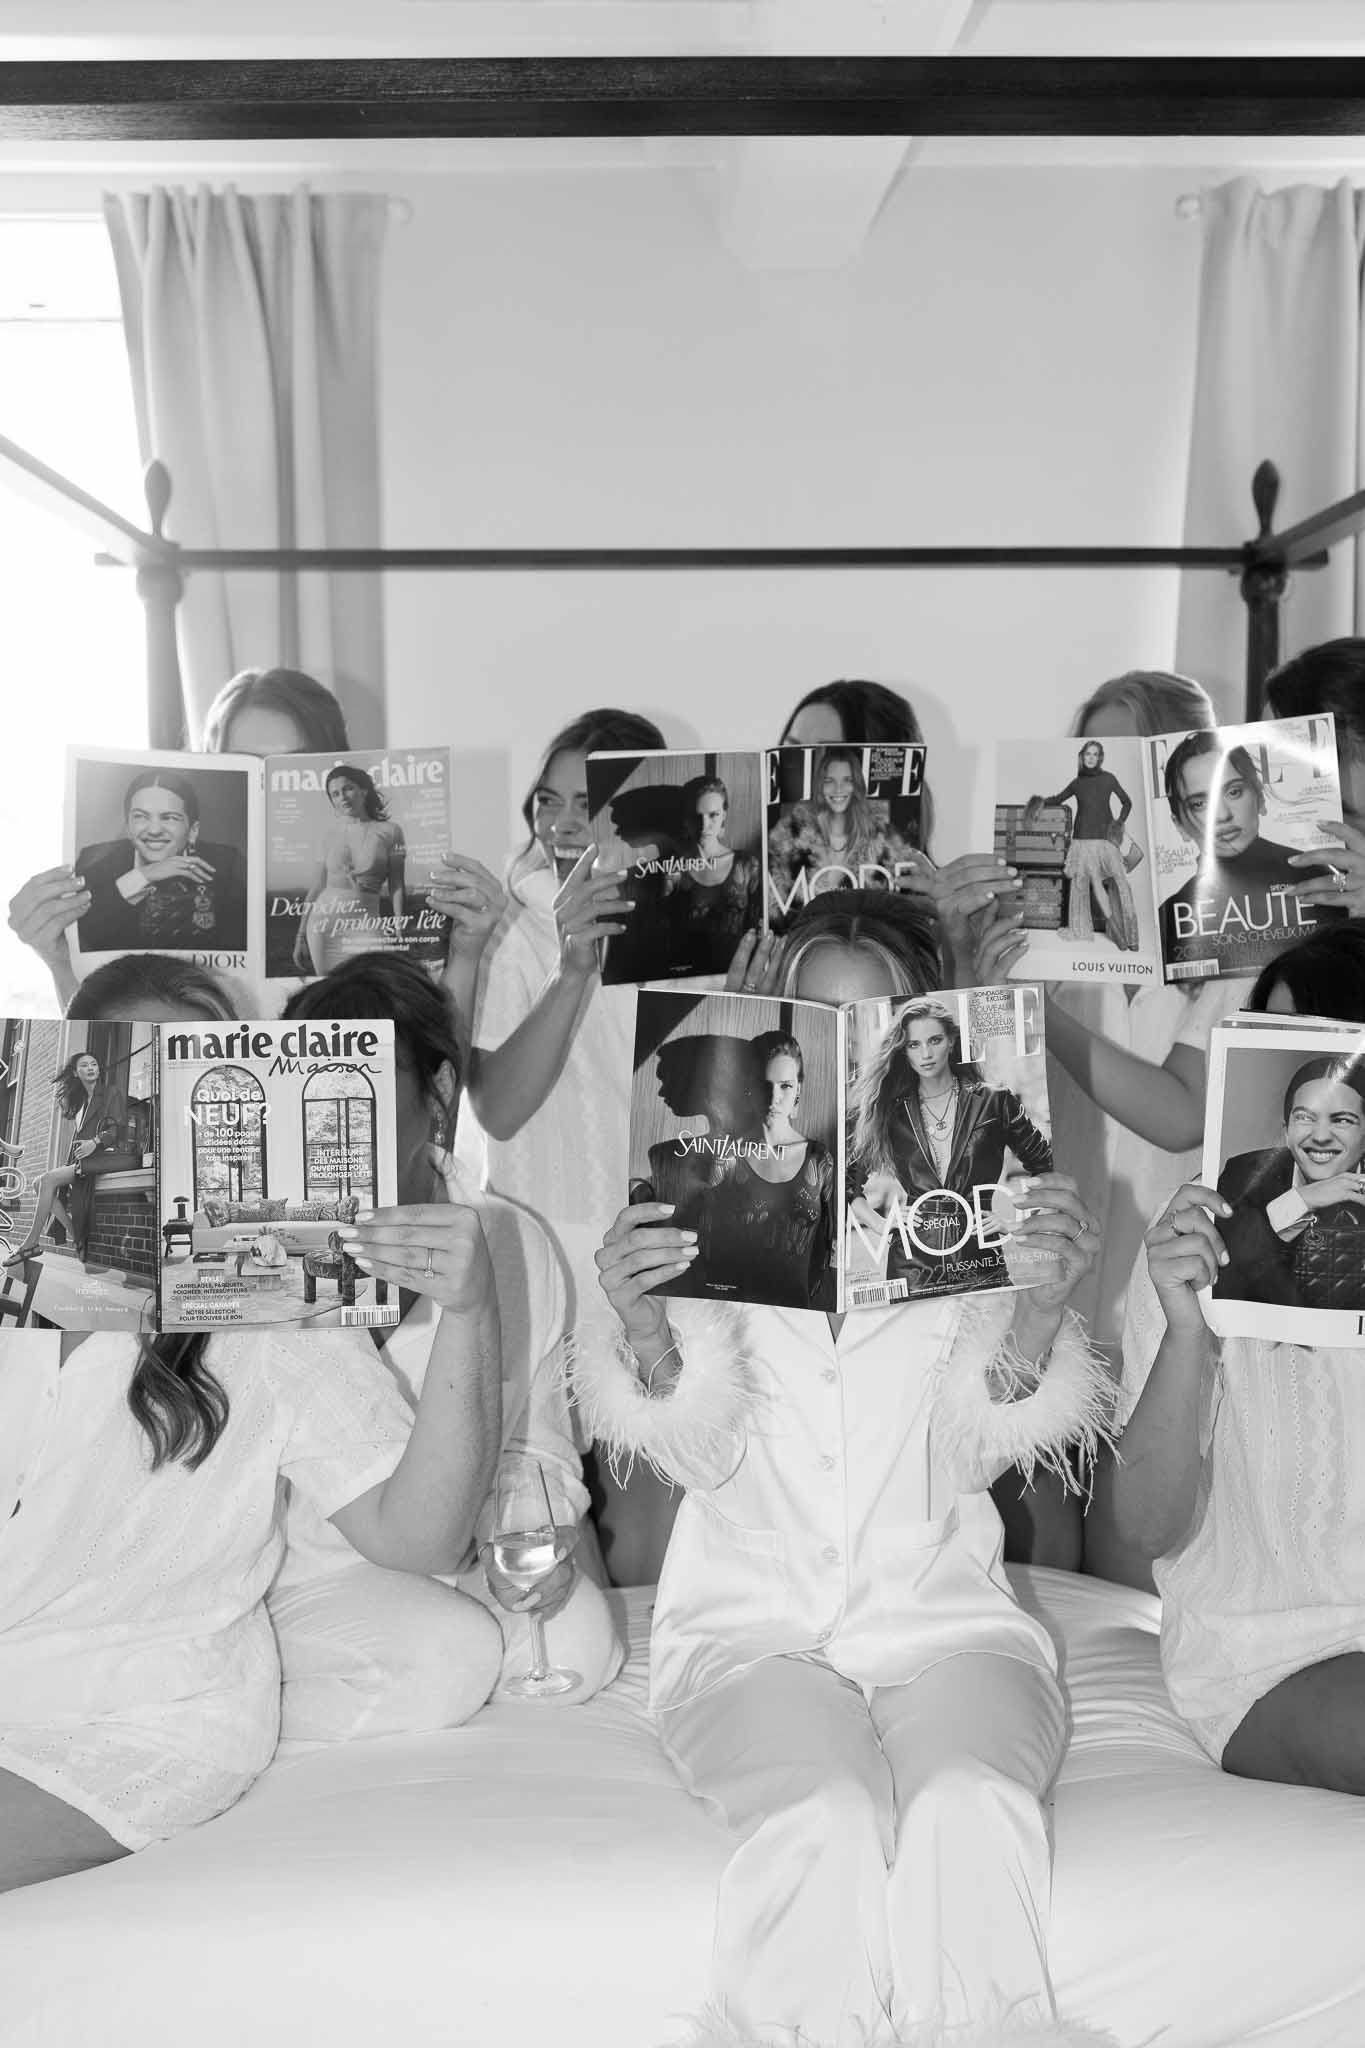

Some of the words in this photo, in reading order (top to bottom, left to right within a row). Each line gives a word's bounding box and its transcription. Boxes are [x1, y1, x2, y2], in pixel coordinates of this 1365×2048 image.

[331, 912, 414, 938] prolonger
[192, 953, 247, 969] DIOR
[1072, 961, 1104, 972] LOUIS
[1108, 963, 1153, 975] VUITTON
[167, 1024, 273, 1060] marie
[280, 1023, 379, 1059] claire
[268, 1055, 383, 1077] Maison
[214, 1128, 234, 1138] 100
